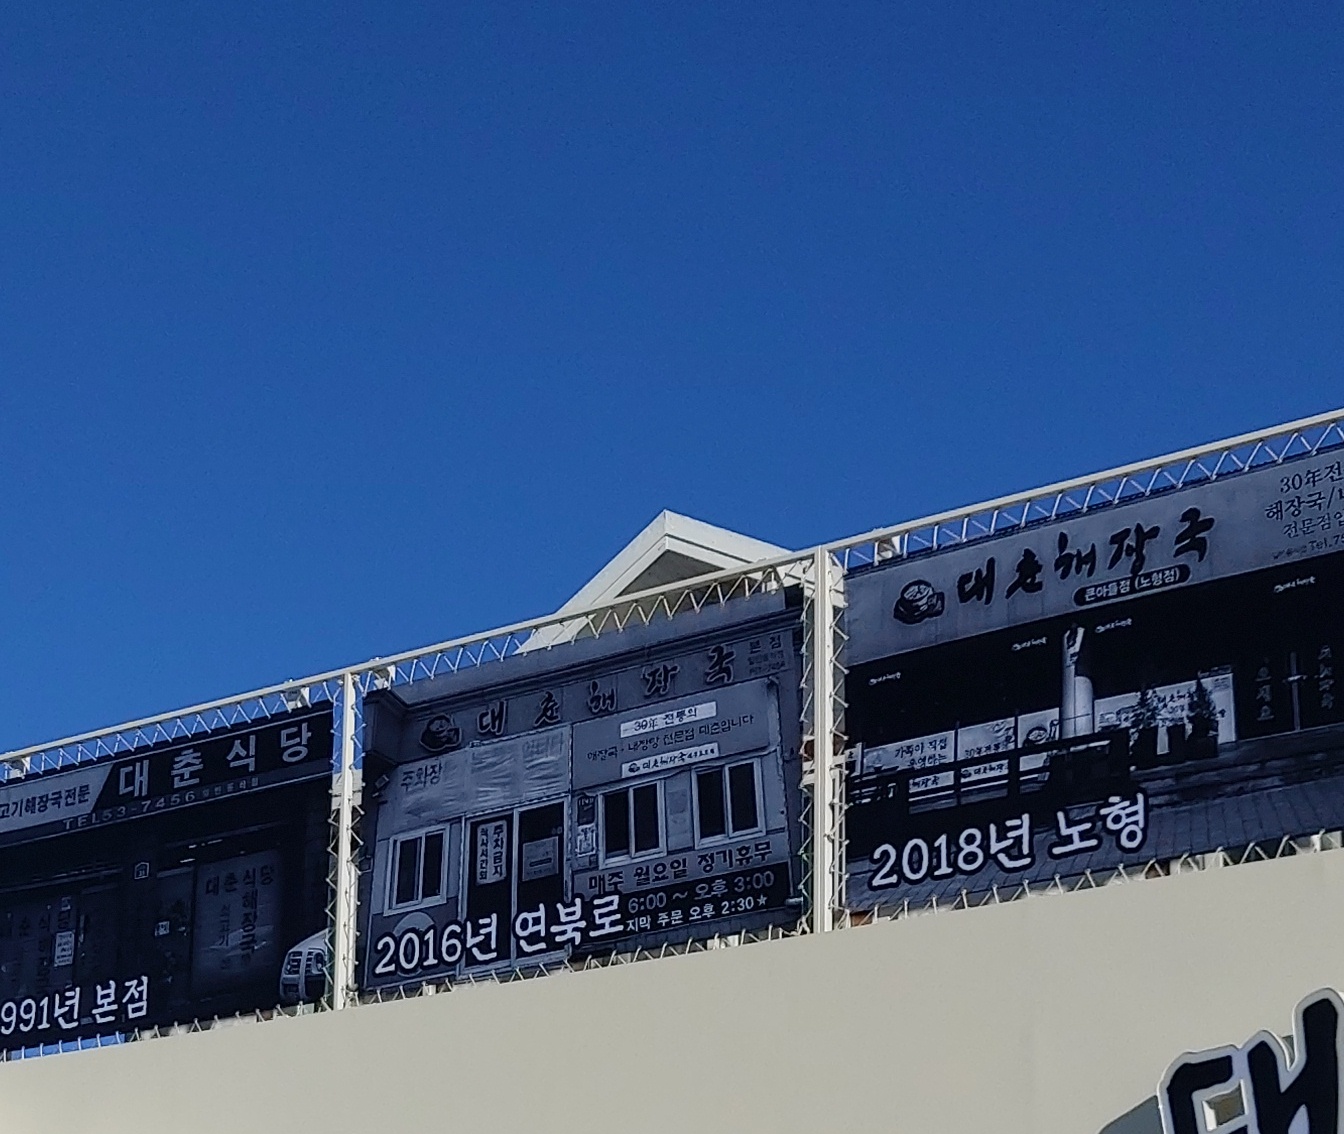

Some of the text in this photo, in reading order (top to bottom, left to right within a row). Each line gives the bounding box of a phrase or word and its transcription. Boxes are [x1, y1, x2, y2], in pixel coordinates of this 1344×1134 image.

[119, 723, 312, 797] 대춘식당
[588, 840, 773, 894] 매주 월요일 정기휴무
[871, 793, 1145, 888] 2018년 노형
[694, 879, 729, 900] 오후
[733, 870, 775, 893] 3:00
[373, 895, 625, 975] 2016년 연북로
[657, 910, 684, 927] 주문
[688, 903, 716, 921] 오후
[91, 975, 149, 1024] 본점
